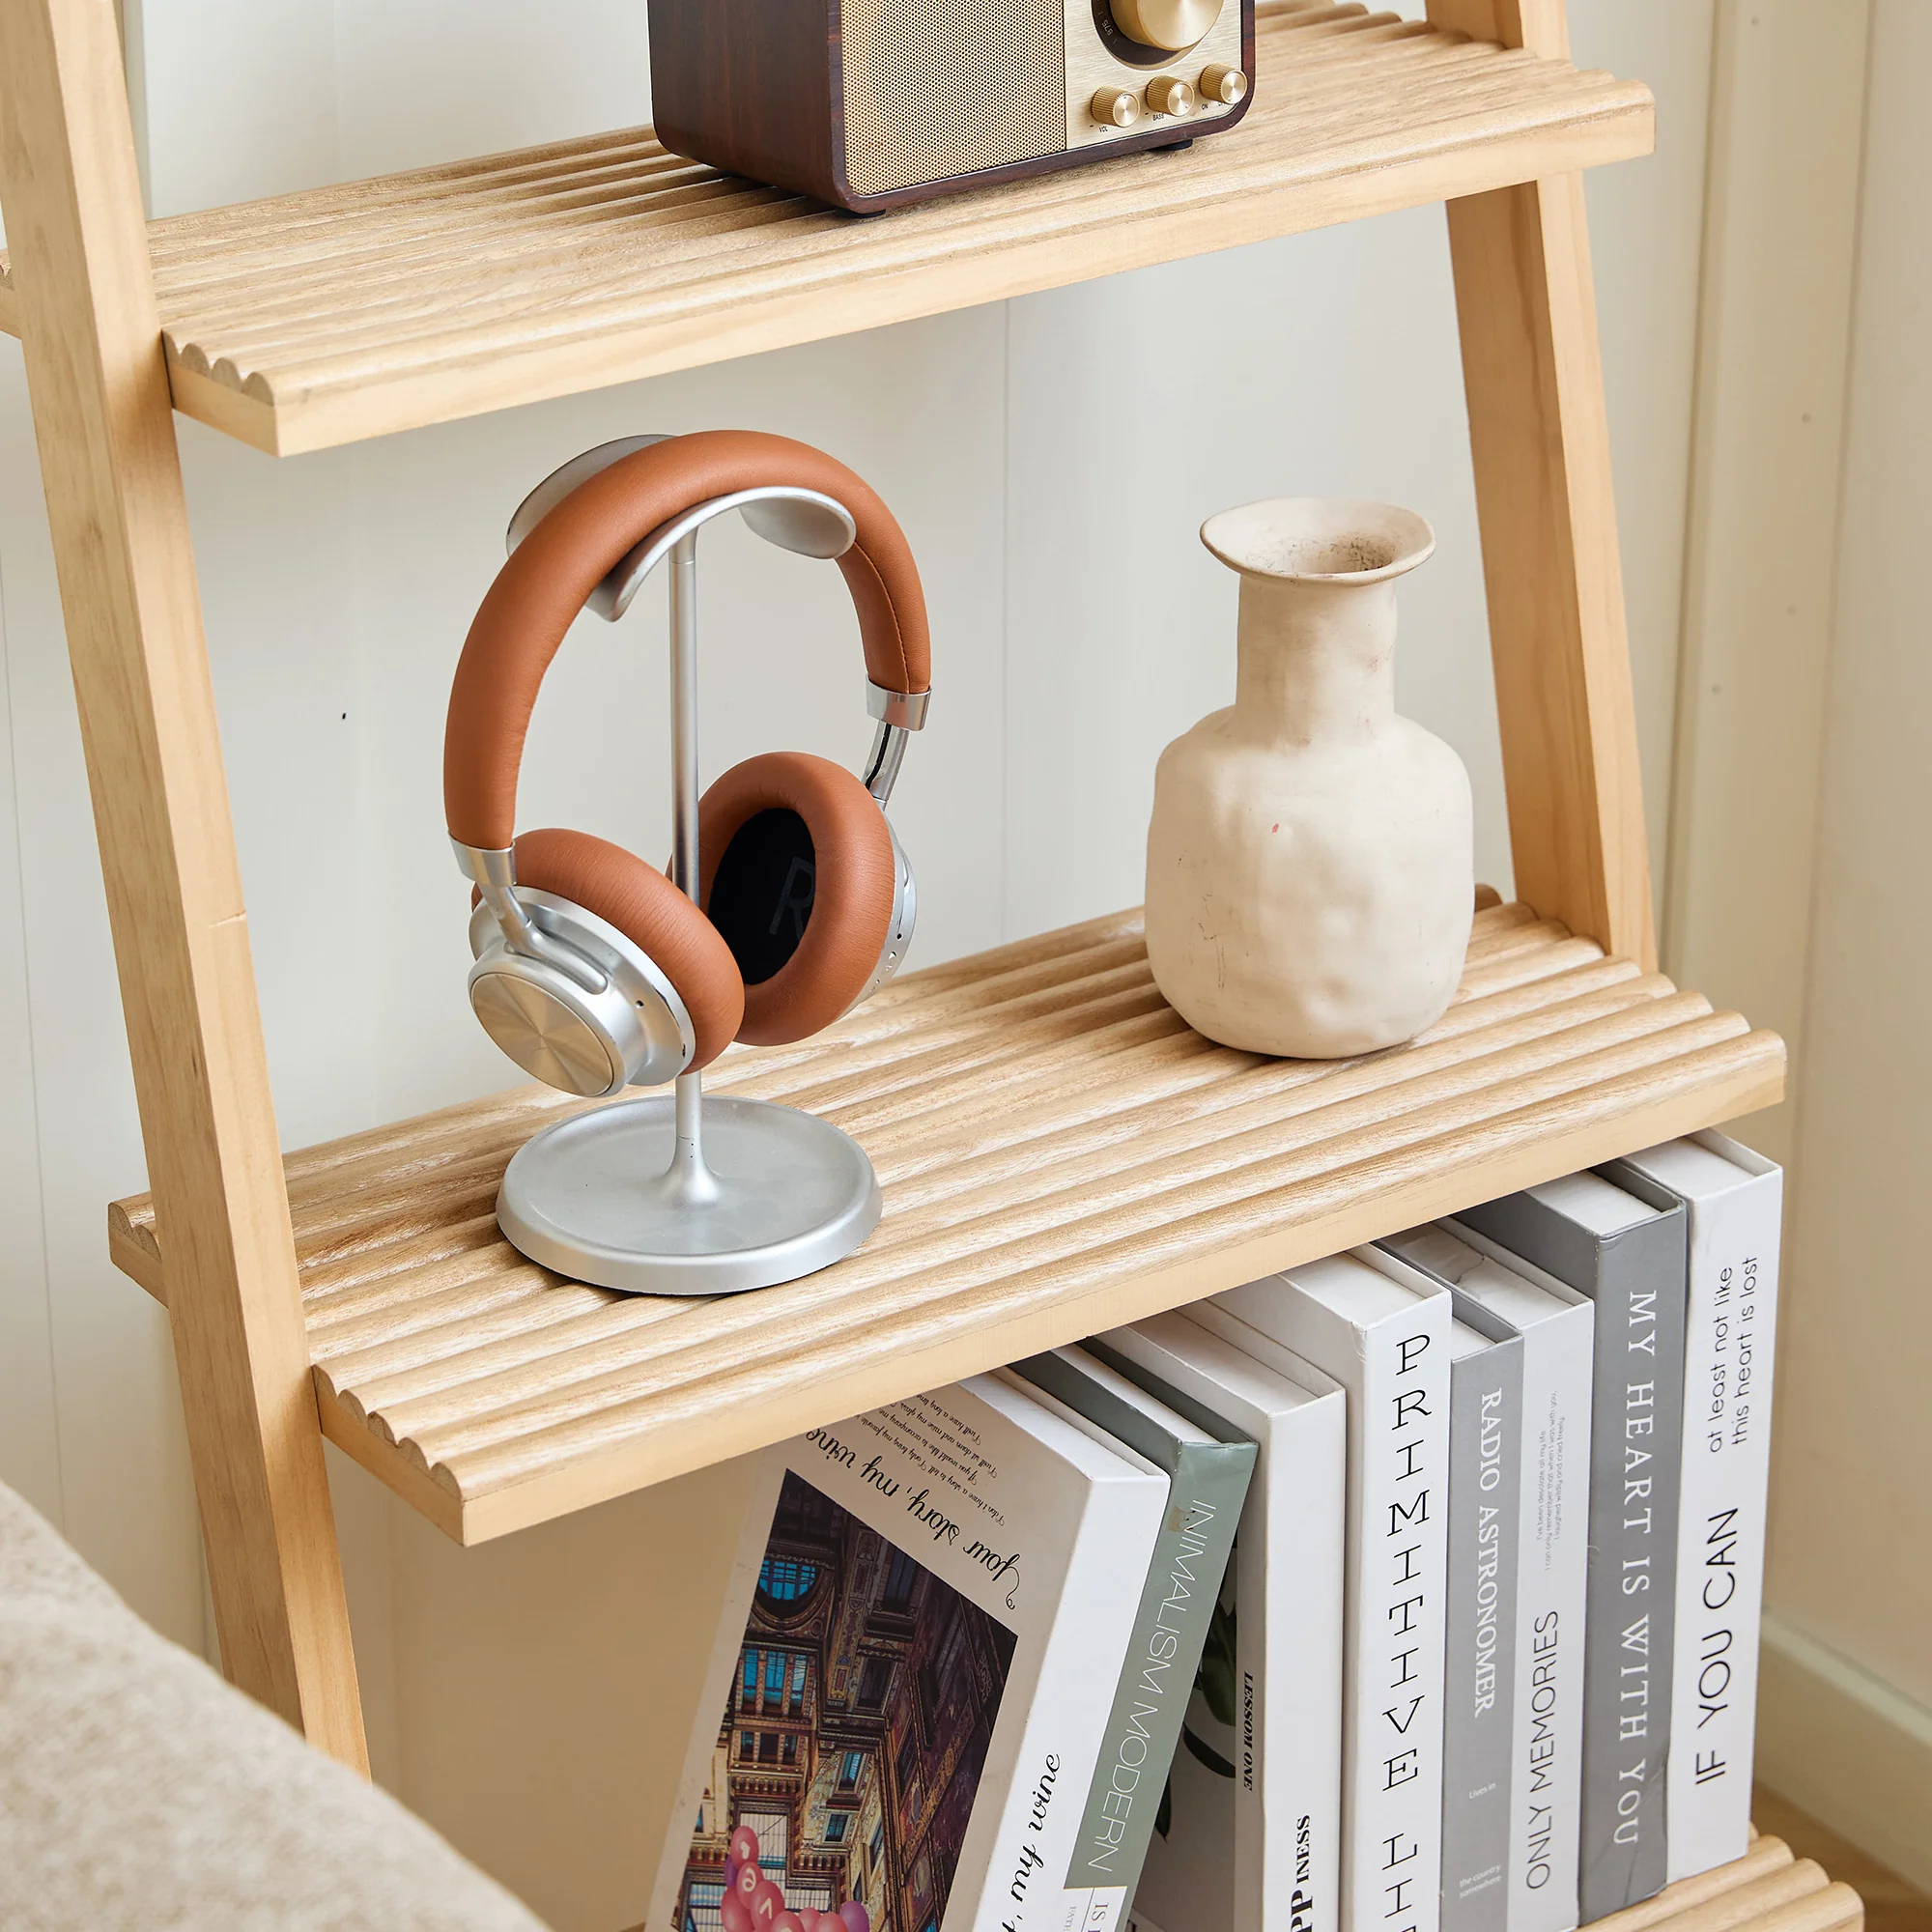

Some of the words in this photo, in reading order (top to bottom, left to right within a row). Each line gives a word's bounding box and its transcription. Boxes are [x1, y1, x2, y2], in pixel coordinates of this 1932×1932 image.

[1152, 113, 1165, 122] BASS
[1714, 1267, 1733, 1307] like
[1739, 1257, 1757, 1298] lost
[1626, 1288, 1658, 1357] MY
[1713, 1316, 1728, 1352] not
[1737, 1305, 1754, 1324] is
[1707, 1363, 1726, 1422] least
[1734, 1333, 1752, 1399] heart
[807, 1429, 856, 1468] wine
[882, 1430, 893, 1440] my
[917, 1412, 926, 1423] my
[941, 1433, 954, 1442] and
[950, 1417, 964, 1431] have
[1480, 1386, 1503, 1492] RADIO
[1707, 1431, 1722, 1453] at
[1731, 1405, 1749, 1445] this
[861, 1456, 899, 1496] my
[959, 1465, 971, 1474] you
[1620, 1378, 1656, 1536] HEART
[969, 1494, 983, 1508] have
[963, 1541, 1020, 1609] Your
[1382, 1332, 1433, 1794] PRIMITIVE
[1621, 1558, 1650, 1598] IS
[1702, 1506, 1740, 1610] CAN
[1139, 1500, 1216, 1693] INIMALISM
[1473, 1505, 1502, 1719] ASTRONOMER
[1529, 1609, 1559, 1794] MEMORIES
[1618, 1610, 1649, 1744] WITH
[1696, 1628, 1734, 1729] YOU
[1089, 1702, 1157, 1871] MODERN
[1693, 1747, 1726, 1786] IF
[1011, 1844, 1043, 1902] my
[1029, 1754, 1060, 1831] wine
[1613, 1755, 1647, 1845] YOU
[1295, 1814, 1311, 1884] INESS
[1525, 1803, 1554, 1890] ONLY
[1380, 1832, 1420, 1932] LI
